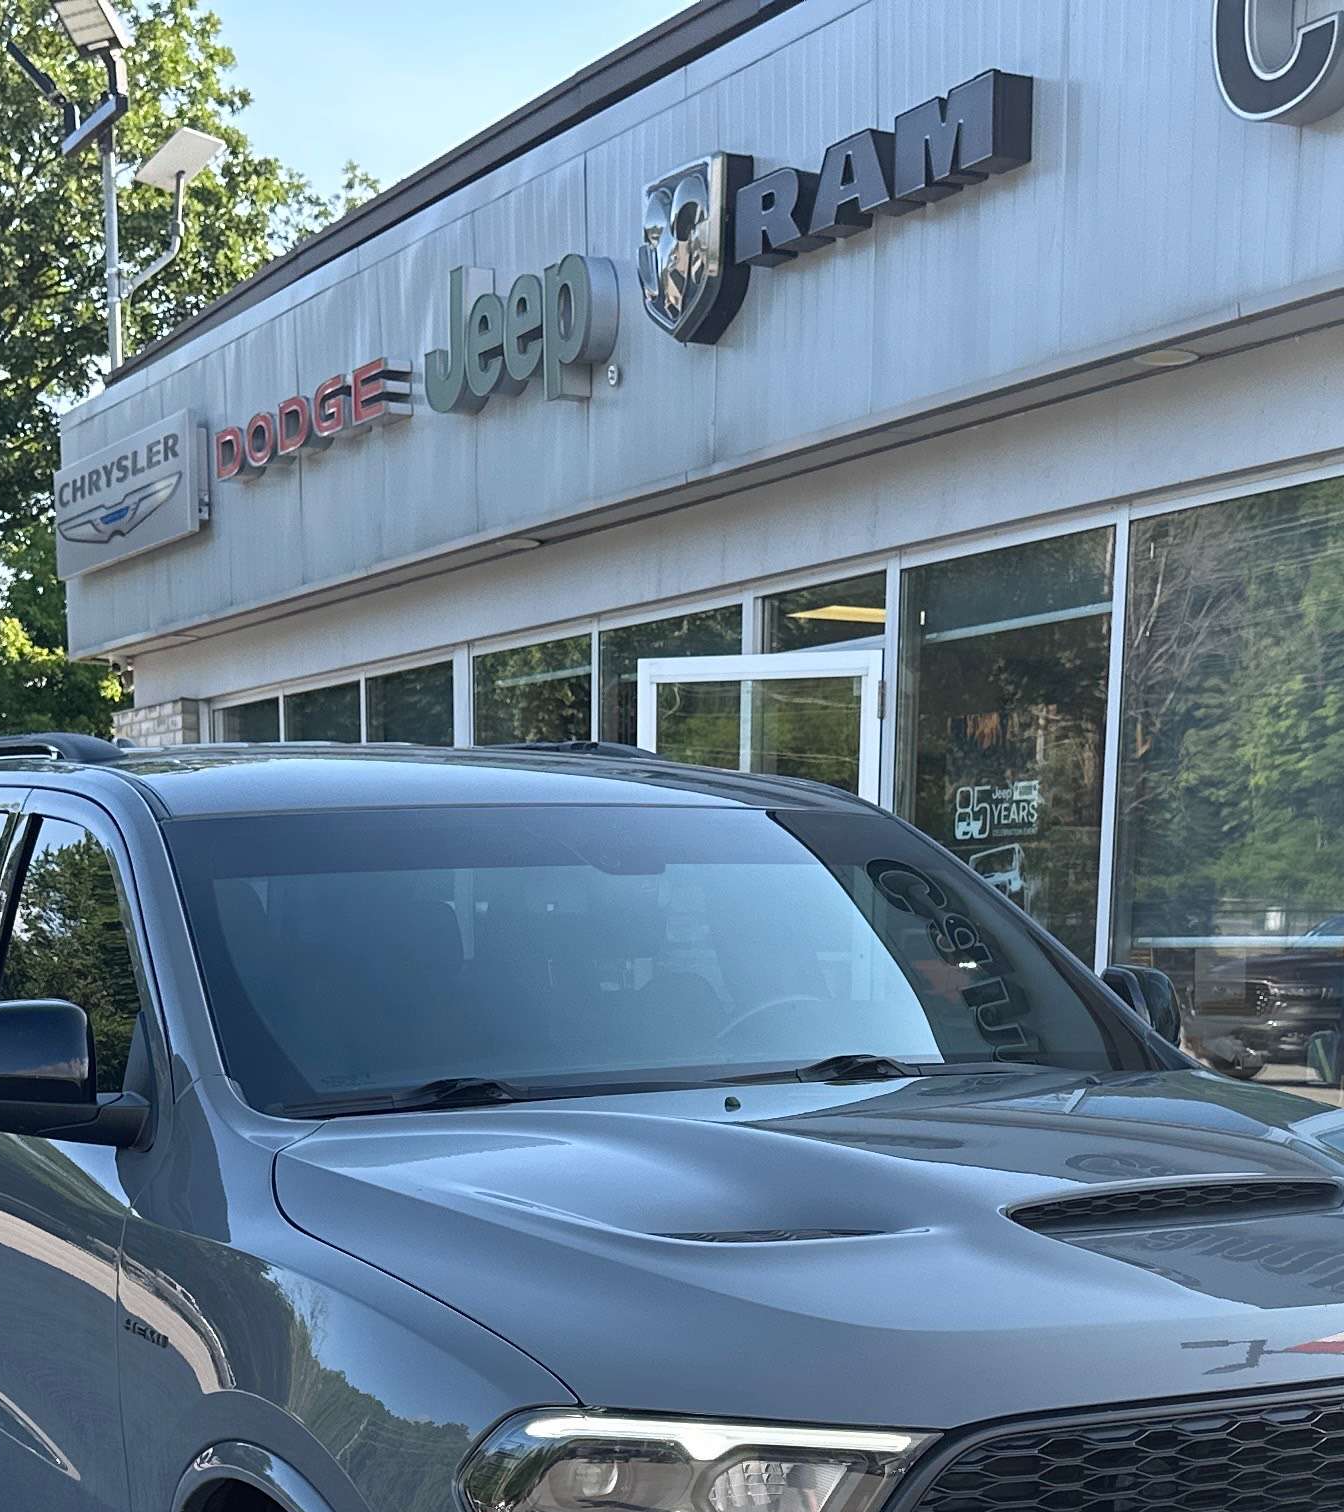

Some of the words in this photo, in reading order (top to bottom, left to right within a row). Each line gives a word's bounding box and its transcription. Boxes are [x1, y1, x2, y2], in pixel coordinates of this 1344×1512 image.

[735, 69, 999, 265] RAM
[425, 253, 593, 413] Jeep
[216, 357, 390, 480] DODGE
[59, 433, 179, 508] CHRYSLER
[955, 786, 991, 840] 85
[992, 787, 1012, 800] Jeep
[992, 801, 1038, 824] YEARS
